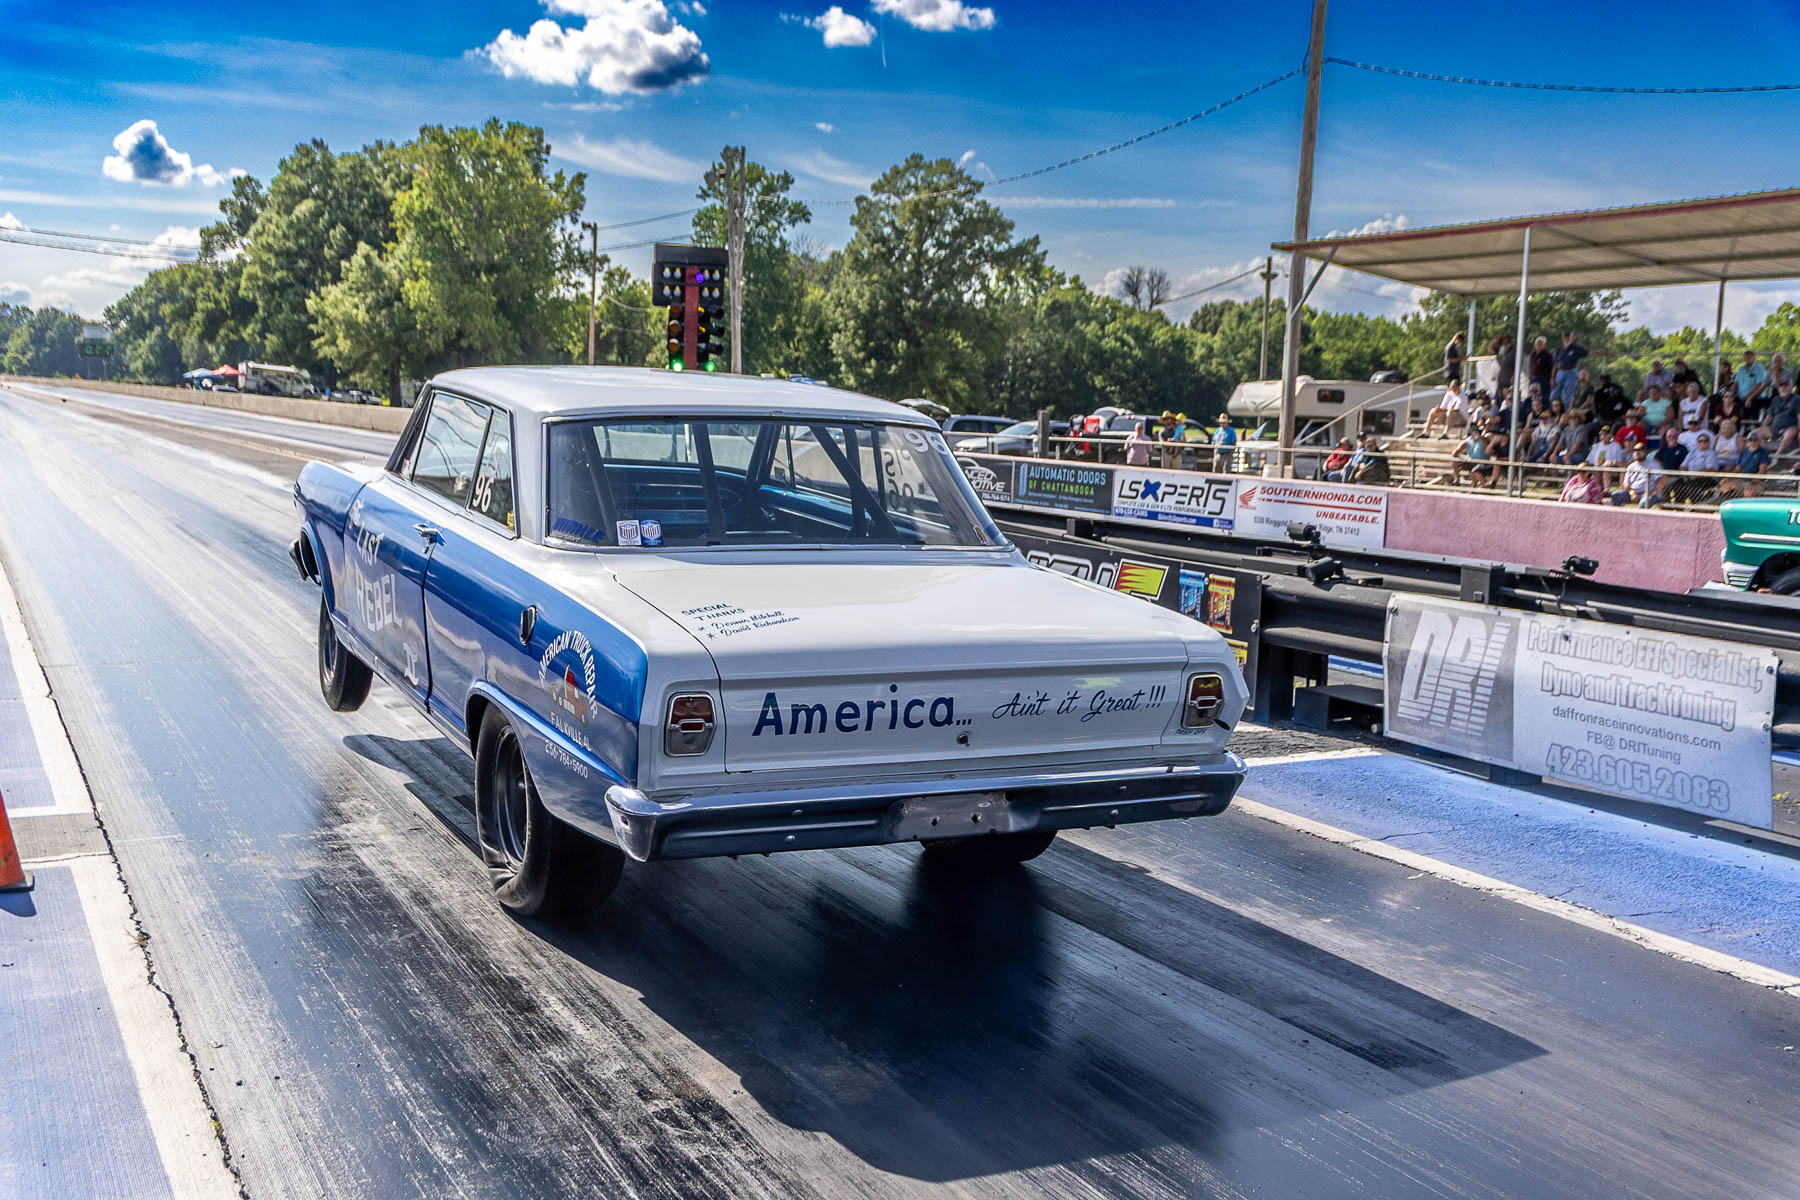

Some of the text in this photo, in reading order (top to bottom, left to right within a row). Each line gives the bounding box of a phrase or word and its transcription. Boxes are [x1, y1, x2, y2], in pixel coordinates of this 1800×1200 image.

[904, 430, 949, 456] 96
[1028, 480, 1095, 496] OF CHATTANOOGA
[1029, 466, 1107, 486] AUTOMATIC DOORS
[472, 472, 494, 512] 96
[1260, 486, 1382, 506] SOUTHERNHONDA.COM
[1173, 505, 1207, 515] PERFORMANCE
[1316, 510, 1380, 525] UNBEATABLE.
[552, 517, 606, 543] MAHLE
[1335, 525, 1343, 534] TN
[356, 521, 385, 566] LAST
[354, 559, 402, 632] REBEL
[681, 603, 732, 615] SPECIAL
[694, 608, 745, 621] THANKS
[720, 625, 751, 637] David
[1527, 620, 1762, 693] Performance EFI Specialist,
[538, 630, 598, 720] AMERICAN TRUCK REPAIR
[1397, 610, 1511, 736] DRI
[992, 690, 1051, 720] Ain't
[1056, 690, 1082, 715] it
[1541, 662, 1738, 730] Dyno and Track Tuning
[1553, 705, 1721, 750] daffronraceinnovations.com
[1619, 738, 1681, 765] DRITuning
[1546, 743, 1730, 813] 423.605.2083
